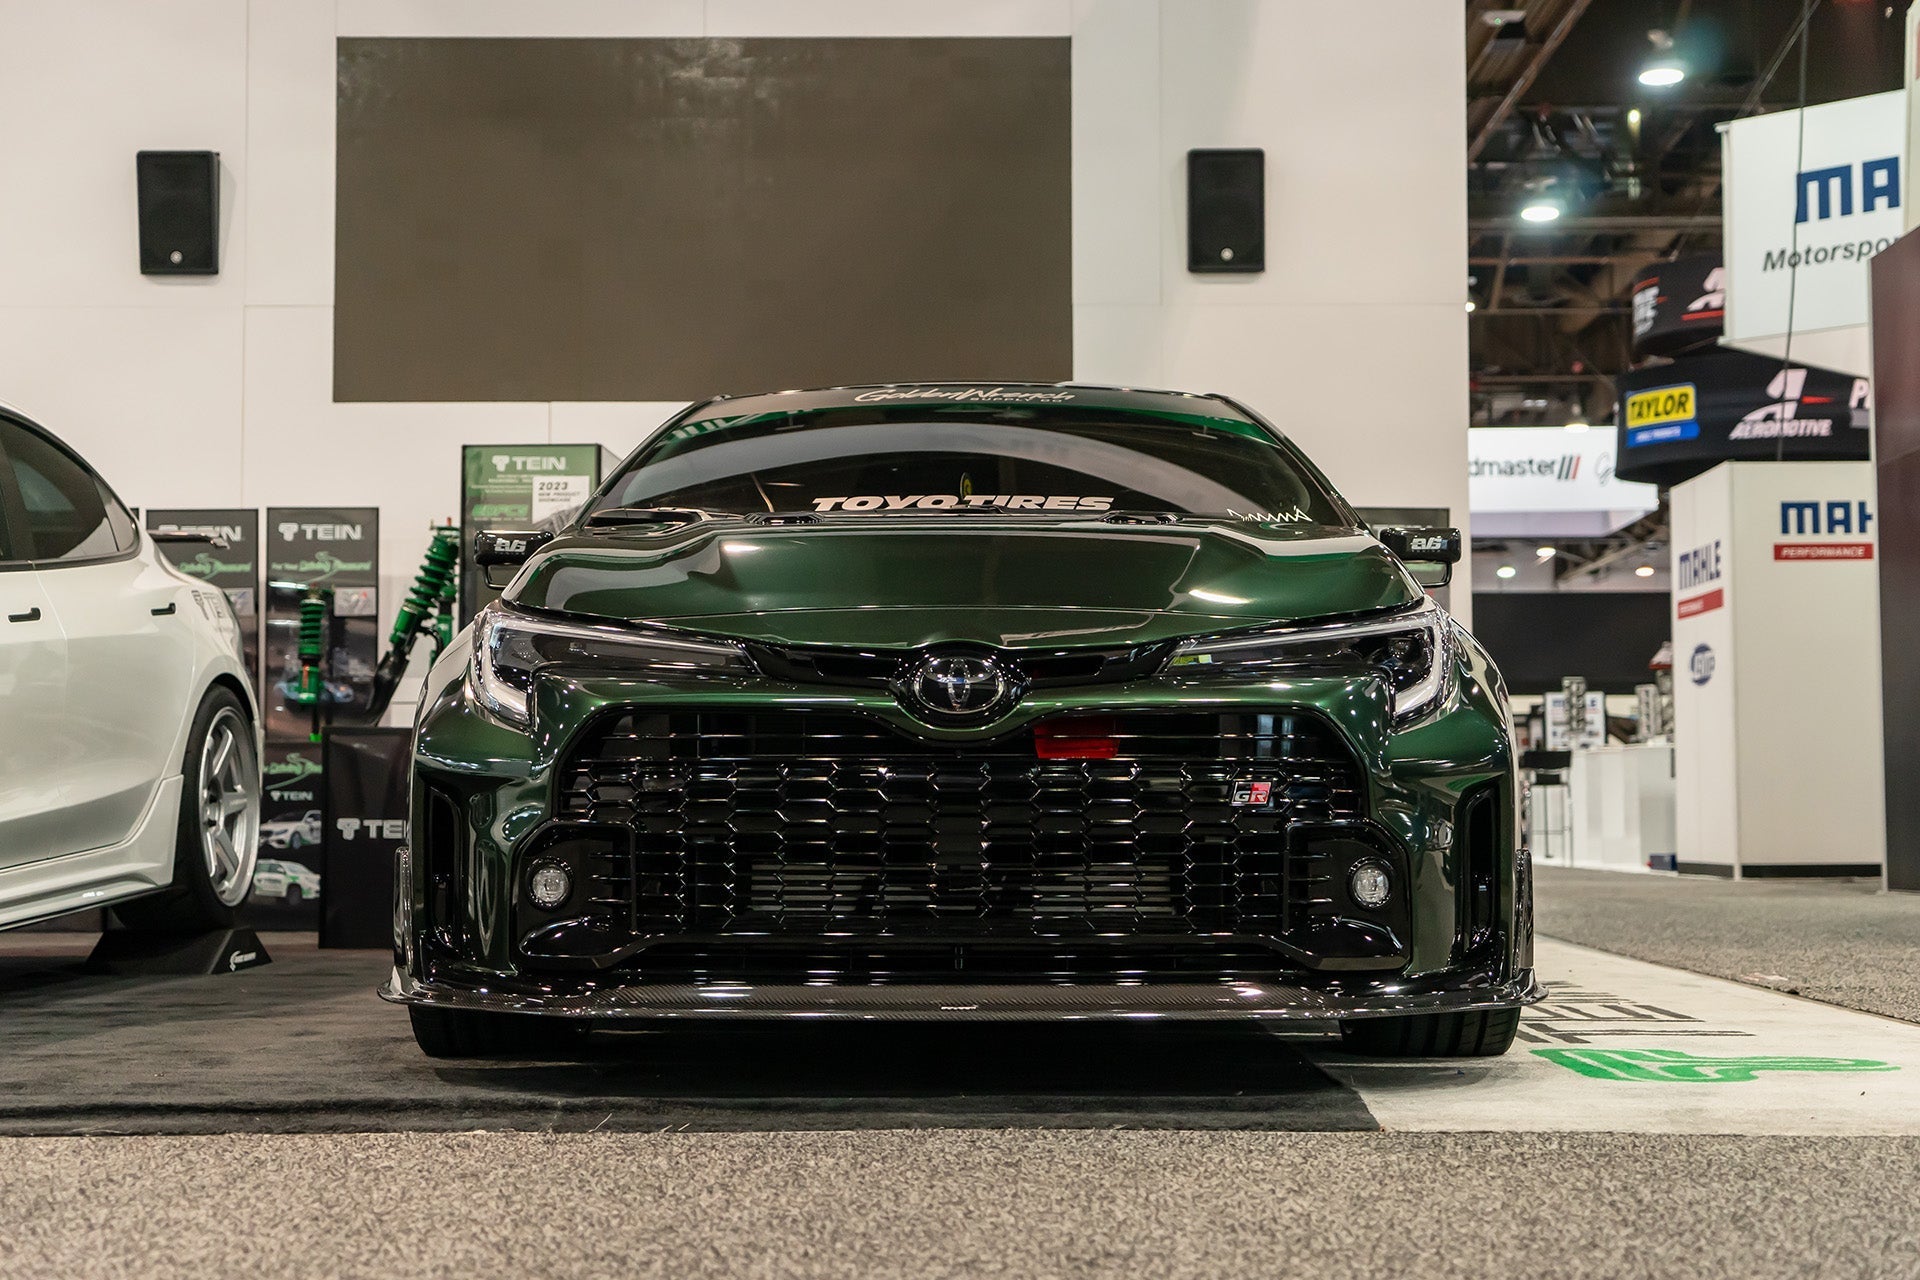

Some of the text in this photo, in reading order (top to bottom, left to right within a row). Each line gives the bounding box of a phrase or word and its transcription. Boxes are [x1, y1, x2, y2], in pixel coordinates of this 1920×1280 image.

[1763, 238, 1899, 272] Motorspo
[1630, 392, 1689, 419] TAYLOR
[1729, 418, 1833, 440] AEROMOTIVE
[512, 456, 566, 471] TEIN
[538, 481, 569, 491] 2023
[812, 495, 1114, 511] TOYO TIRES
[301, 523, 362, 541] TEIN
[1780, 546, 1865, 558] PERFORMANCE
[1678, 541, 1721, 591] MAHLE
[281, 791, 313, 801] TEIN
[1234, 790, 1268, 802] GR
